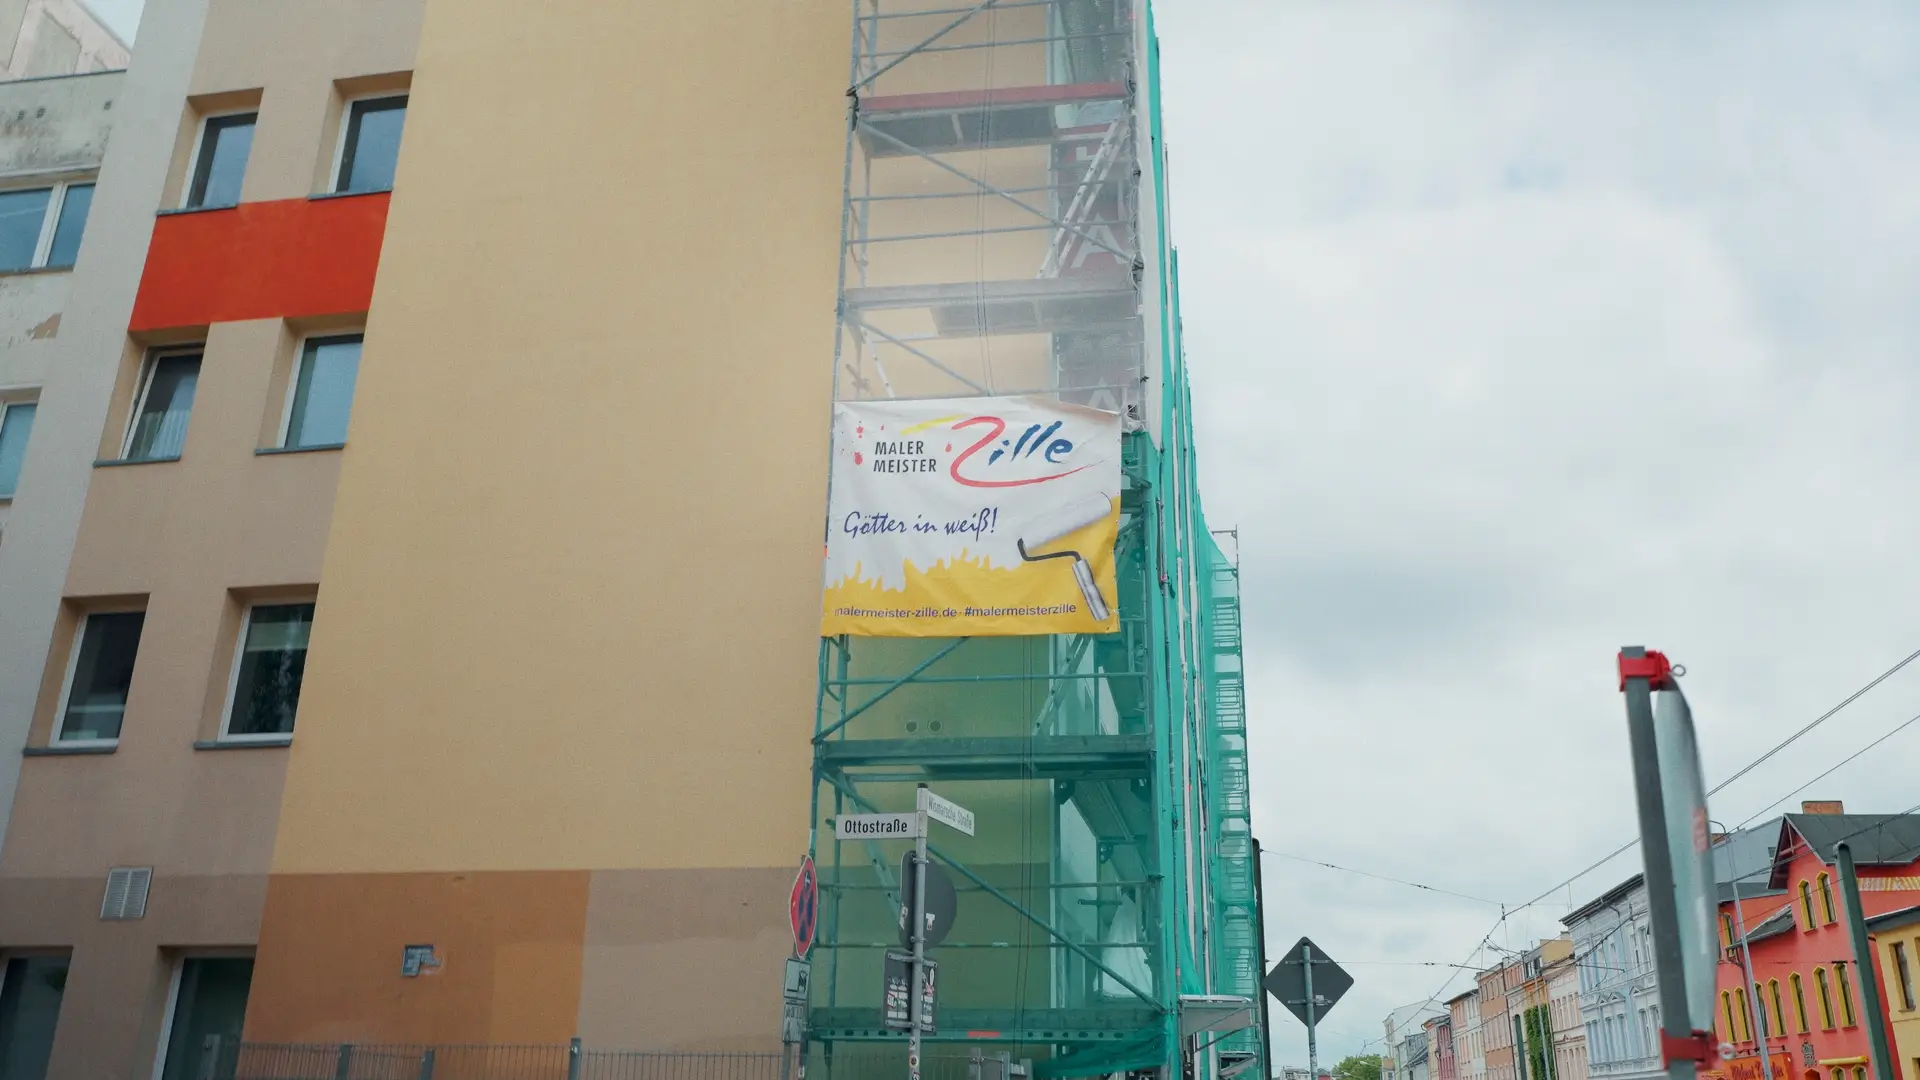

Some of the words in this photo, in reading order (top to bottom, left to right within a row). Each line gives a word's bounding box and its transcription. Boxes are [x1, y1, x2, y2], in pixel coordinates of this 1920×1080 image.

[875, 440, 924, 455] MALER
[950, 416, 1104, 488] Zille
[873, 458, 937, 473] MEISTER
[843, 511, 907, 539] Götter
[913, 514, 938, 534] in
[944, 507, 998, 542] weiß!
[834, 606, 957, 618] malermeister-zille.de
[964, 603, 1077, 617] #malermeisterzille
[844, 818, 908, 834] Ottostraße
